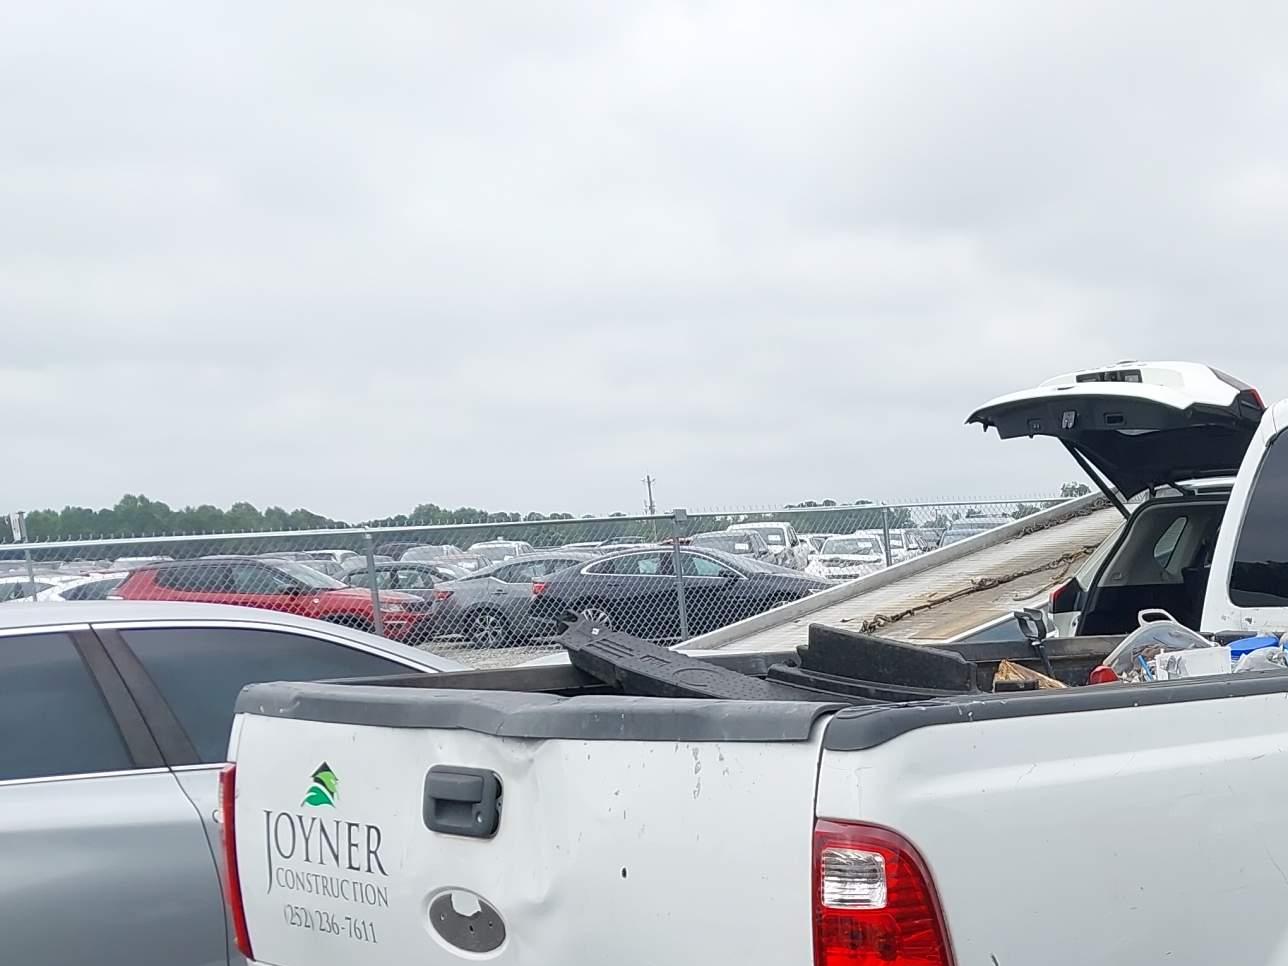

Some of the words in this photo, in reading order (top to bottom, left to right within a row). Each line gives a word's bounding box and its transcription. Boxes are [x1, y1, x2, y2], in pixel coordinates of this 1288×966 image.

[263, 809, 389, 894] JOYNER
[275, 866, 390, 908] CONSTRUCTION
[283, 903, 315, 930] (252)
[315, 909, 378, 944] 236-7611
